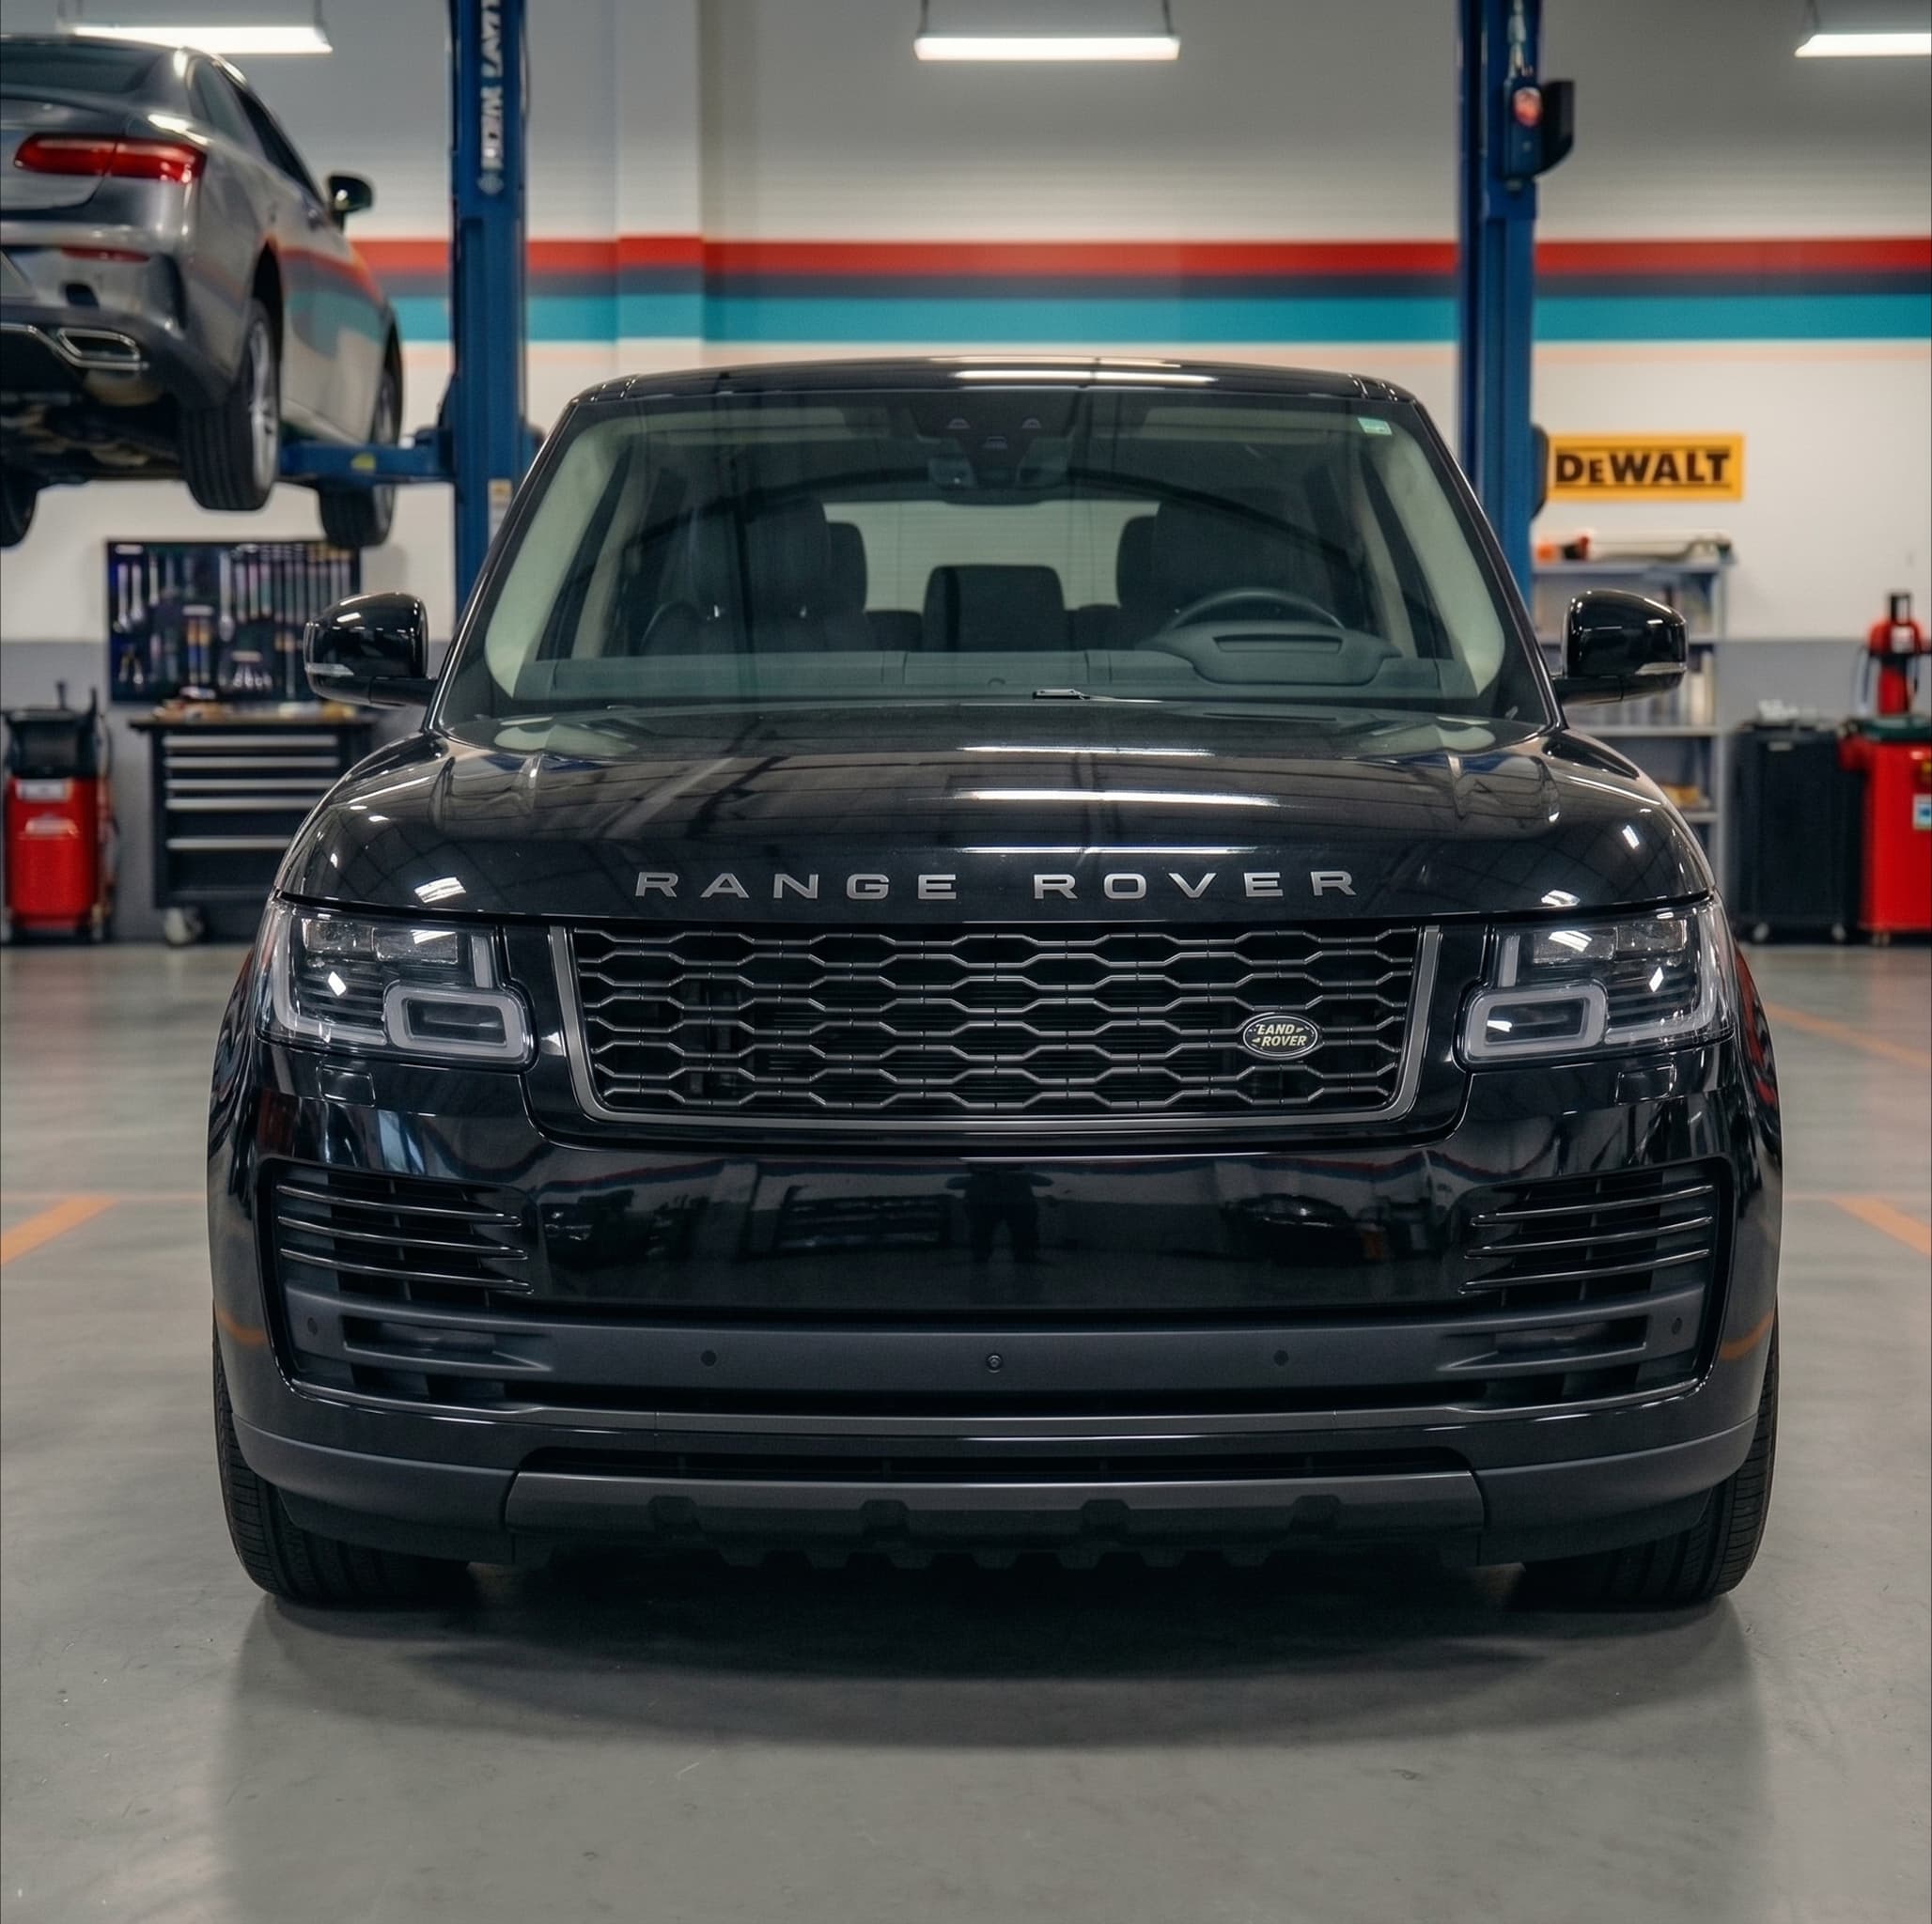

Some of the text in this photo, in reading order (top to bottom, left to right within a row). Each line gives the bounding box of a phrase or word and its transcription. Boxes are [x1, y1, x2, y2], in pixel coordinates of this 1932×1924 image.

[634, 871, 1357, 899] RANGE ROVER
[1257, 1024, 1295, 1035] LAND
[1261, 1035, 1307, 1047] ROVER
